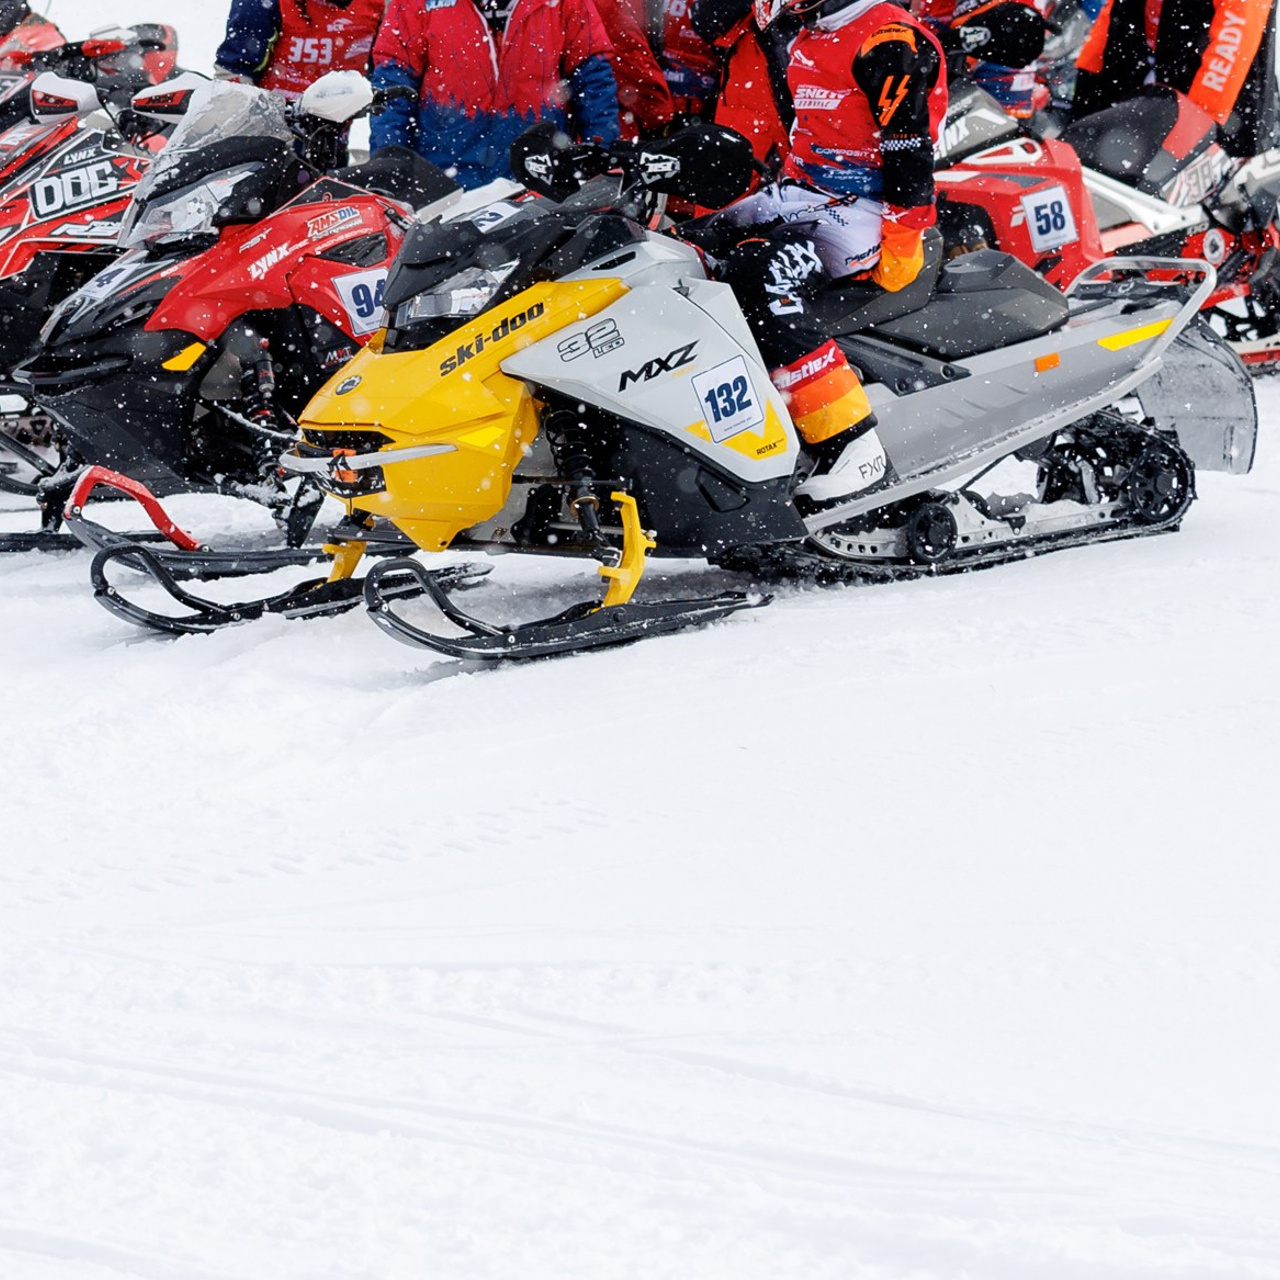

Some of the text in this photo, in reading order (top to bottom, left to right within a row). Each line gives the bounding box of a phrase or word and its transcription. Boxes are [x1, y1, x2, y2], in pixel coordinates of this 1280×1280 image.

[288, 36, 333, 65] 353
[1200, 8, 1247, 93] READY
[63, 148, 97, 165] LYNX
[308, 206, 360, 237] AMSOIL
[1034, 200, 1066, 236] 58
[247, 241, 291, 280] LYNX
[351, 278, 387, 318] 94
[439, 302, 545, 377] ski-doo
[556, 318, 620, 363] 32
[618, 339, 701, 393] MXZ
[704, 375, 753, 424] 132
[756, 442, 778, 456] ROTAX
[858, 454, 887, 480] FXR
